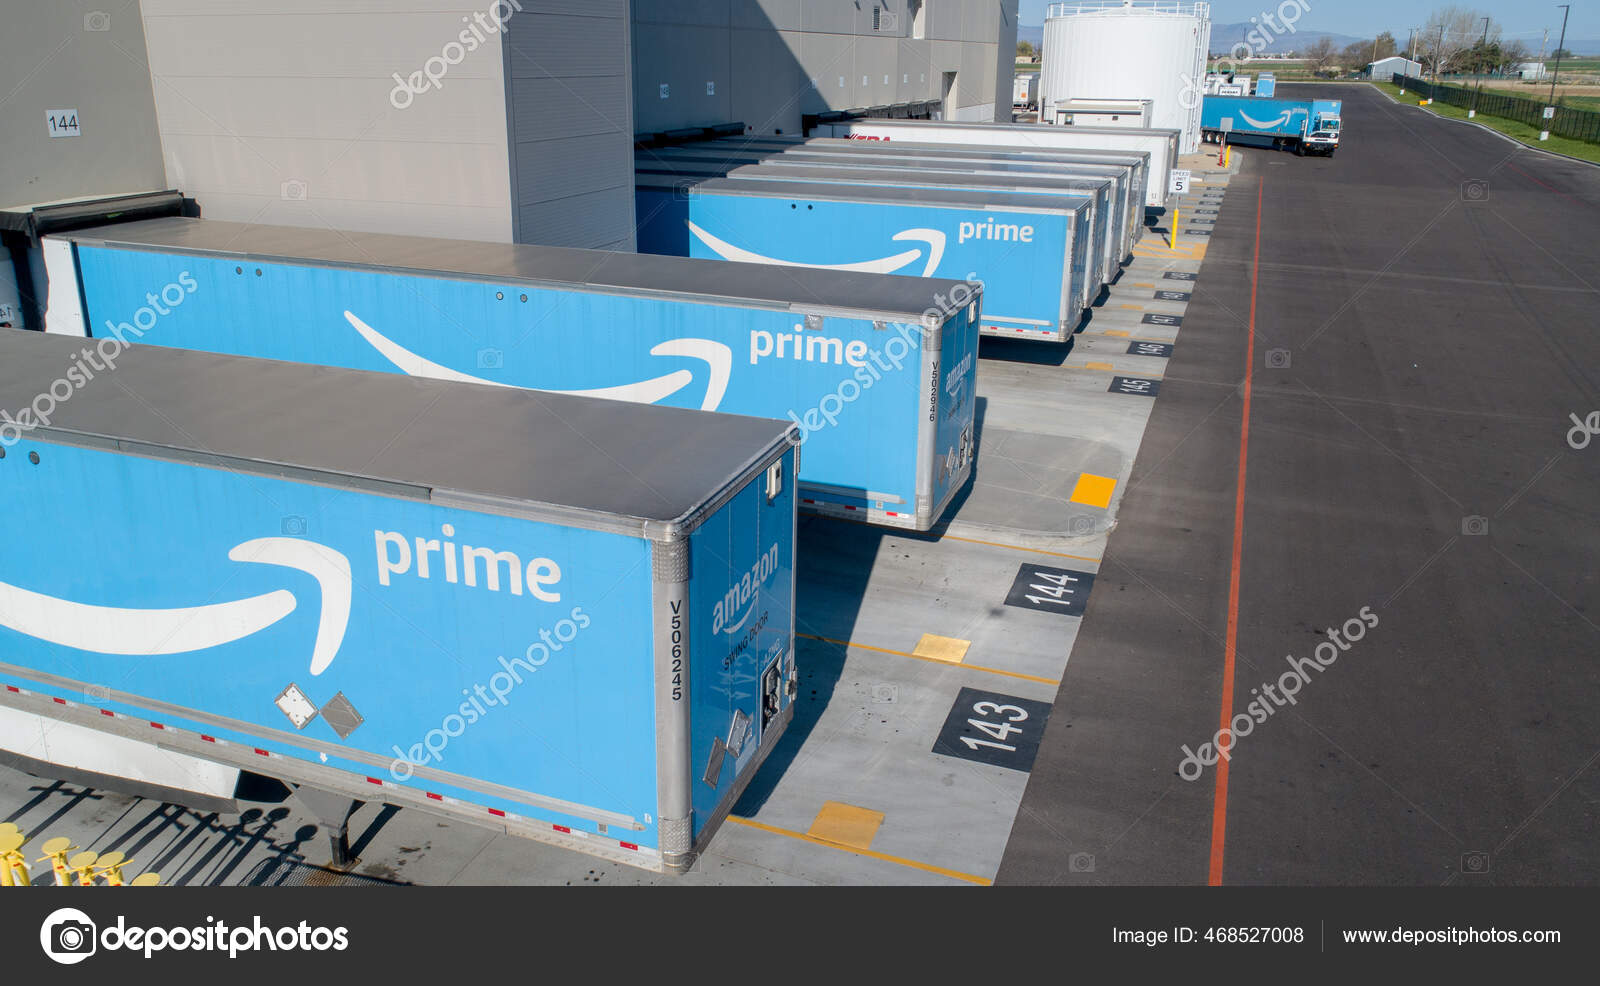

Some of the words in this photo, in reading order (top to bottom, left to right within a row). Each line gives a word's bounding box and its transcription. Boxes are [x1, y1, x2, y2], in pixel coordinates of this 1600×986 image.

[49, 115, 79, 131] 144
[1175, 181, 1183, 191] 5
[958, 217, 1034, 244] prime
[750, 324, 868, 368] prime
[1136, 343, 1165, 355] 146
[945, 353, 971, 393] amazon
[1120, 379, 1151, 393] 145
[374, 524, 561, 602] prime
[712, 542, 778, 635] amazon
[1024, 572, 1079, 605] 144
[670, 600, 682, 701] V506245
[724, 635, 748, 671] SWING
[750, 610, 769, 642] DOOR
[959, 701, 1029, 752] 143
